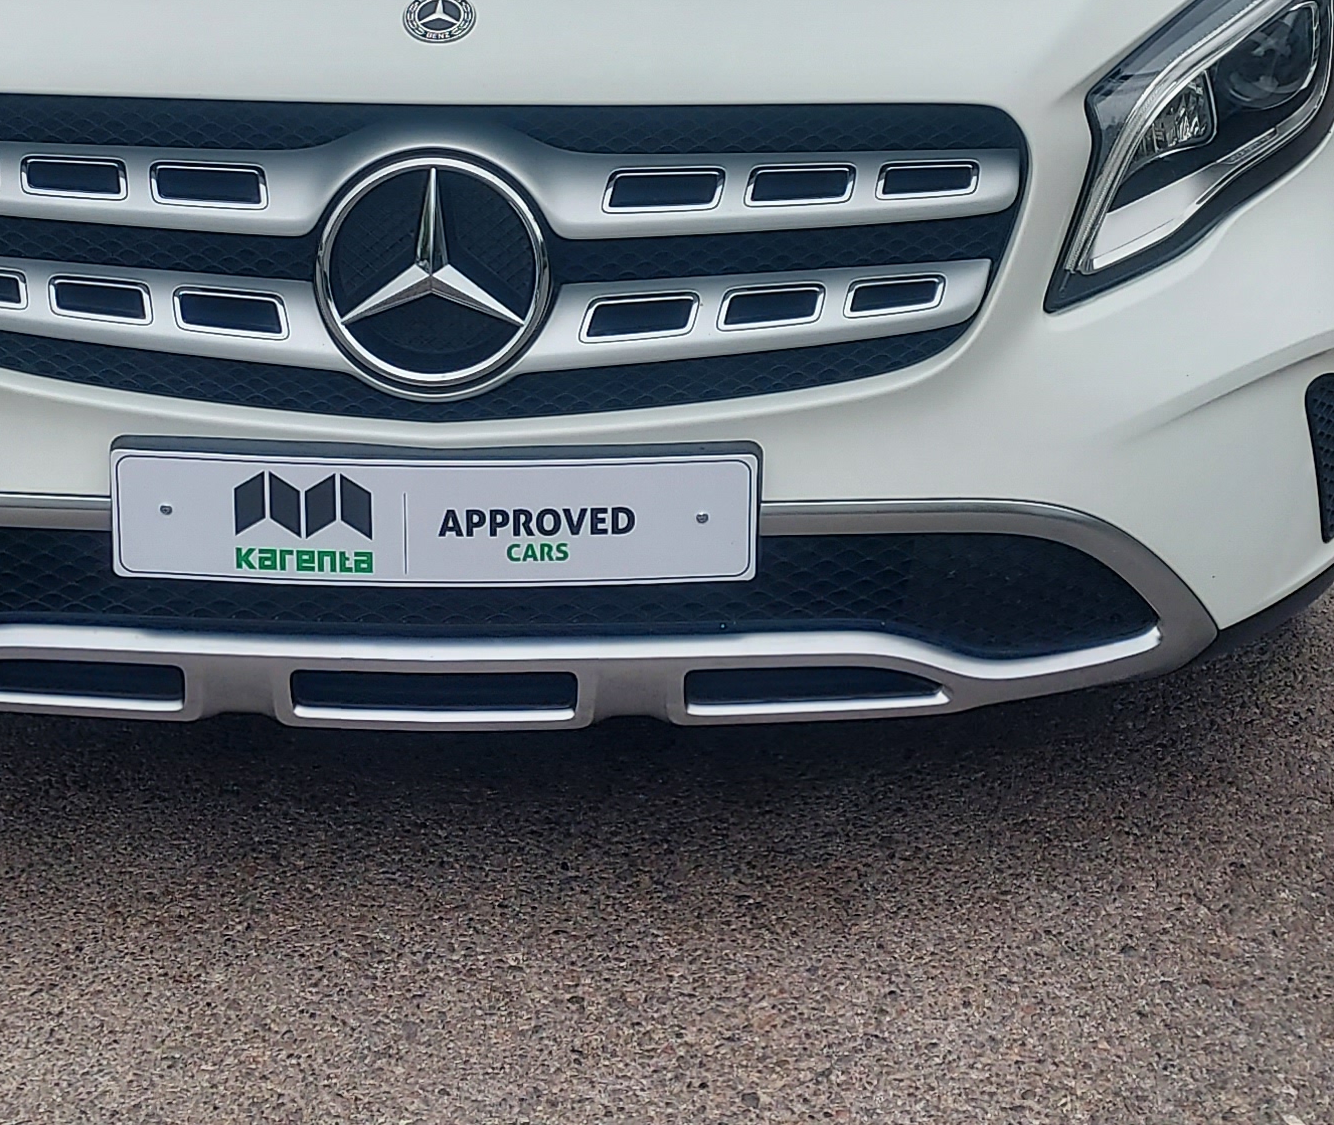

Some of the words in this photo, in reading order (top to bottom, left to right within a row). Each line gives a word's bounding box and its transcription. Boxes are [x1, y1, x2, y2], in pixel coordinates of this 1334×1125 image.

[425, 31, 451, 39] BENZ
[438, 507, 636, 537] APPROVED
[506, 543, 570, 562] CARS
